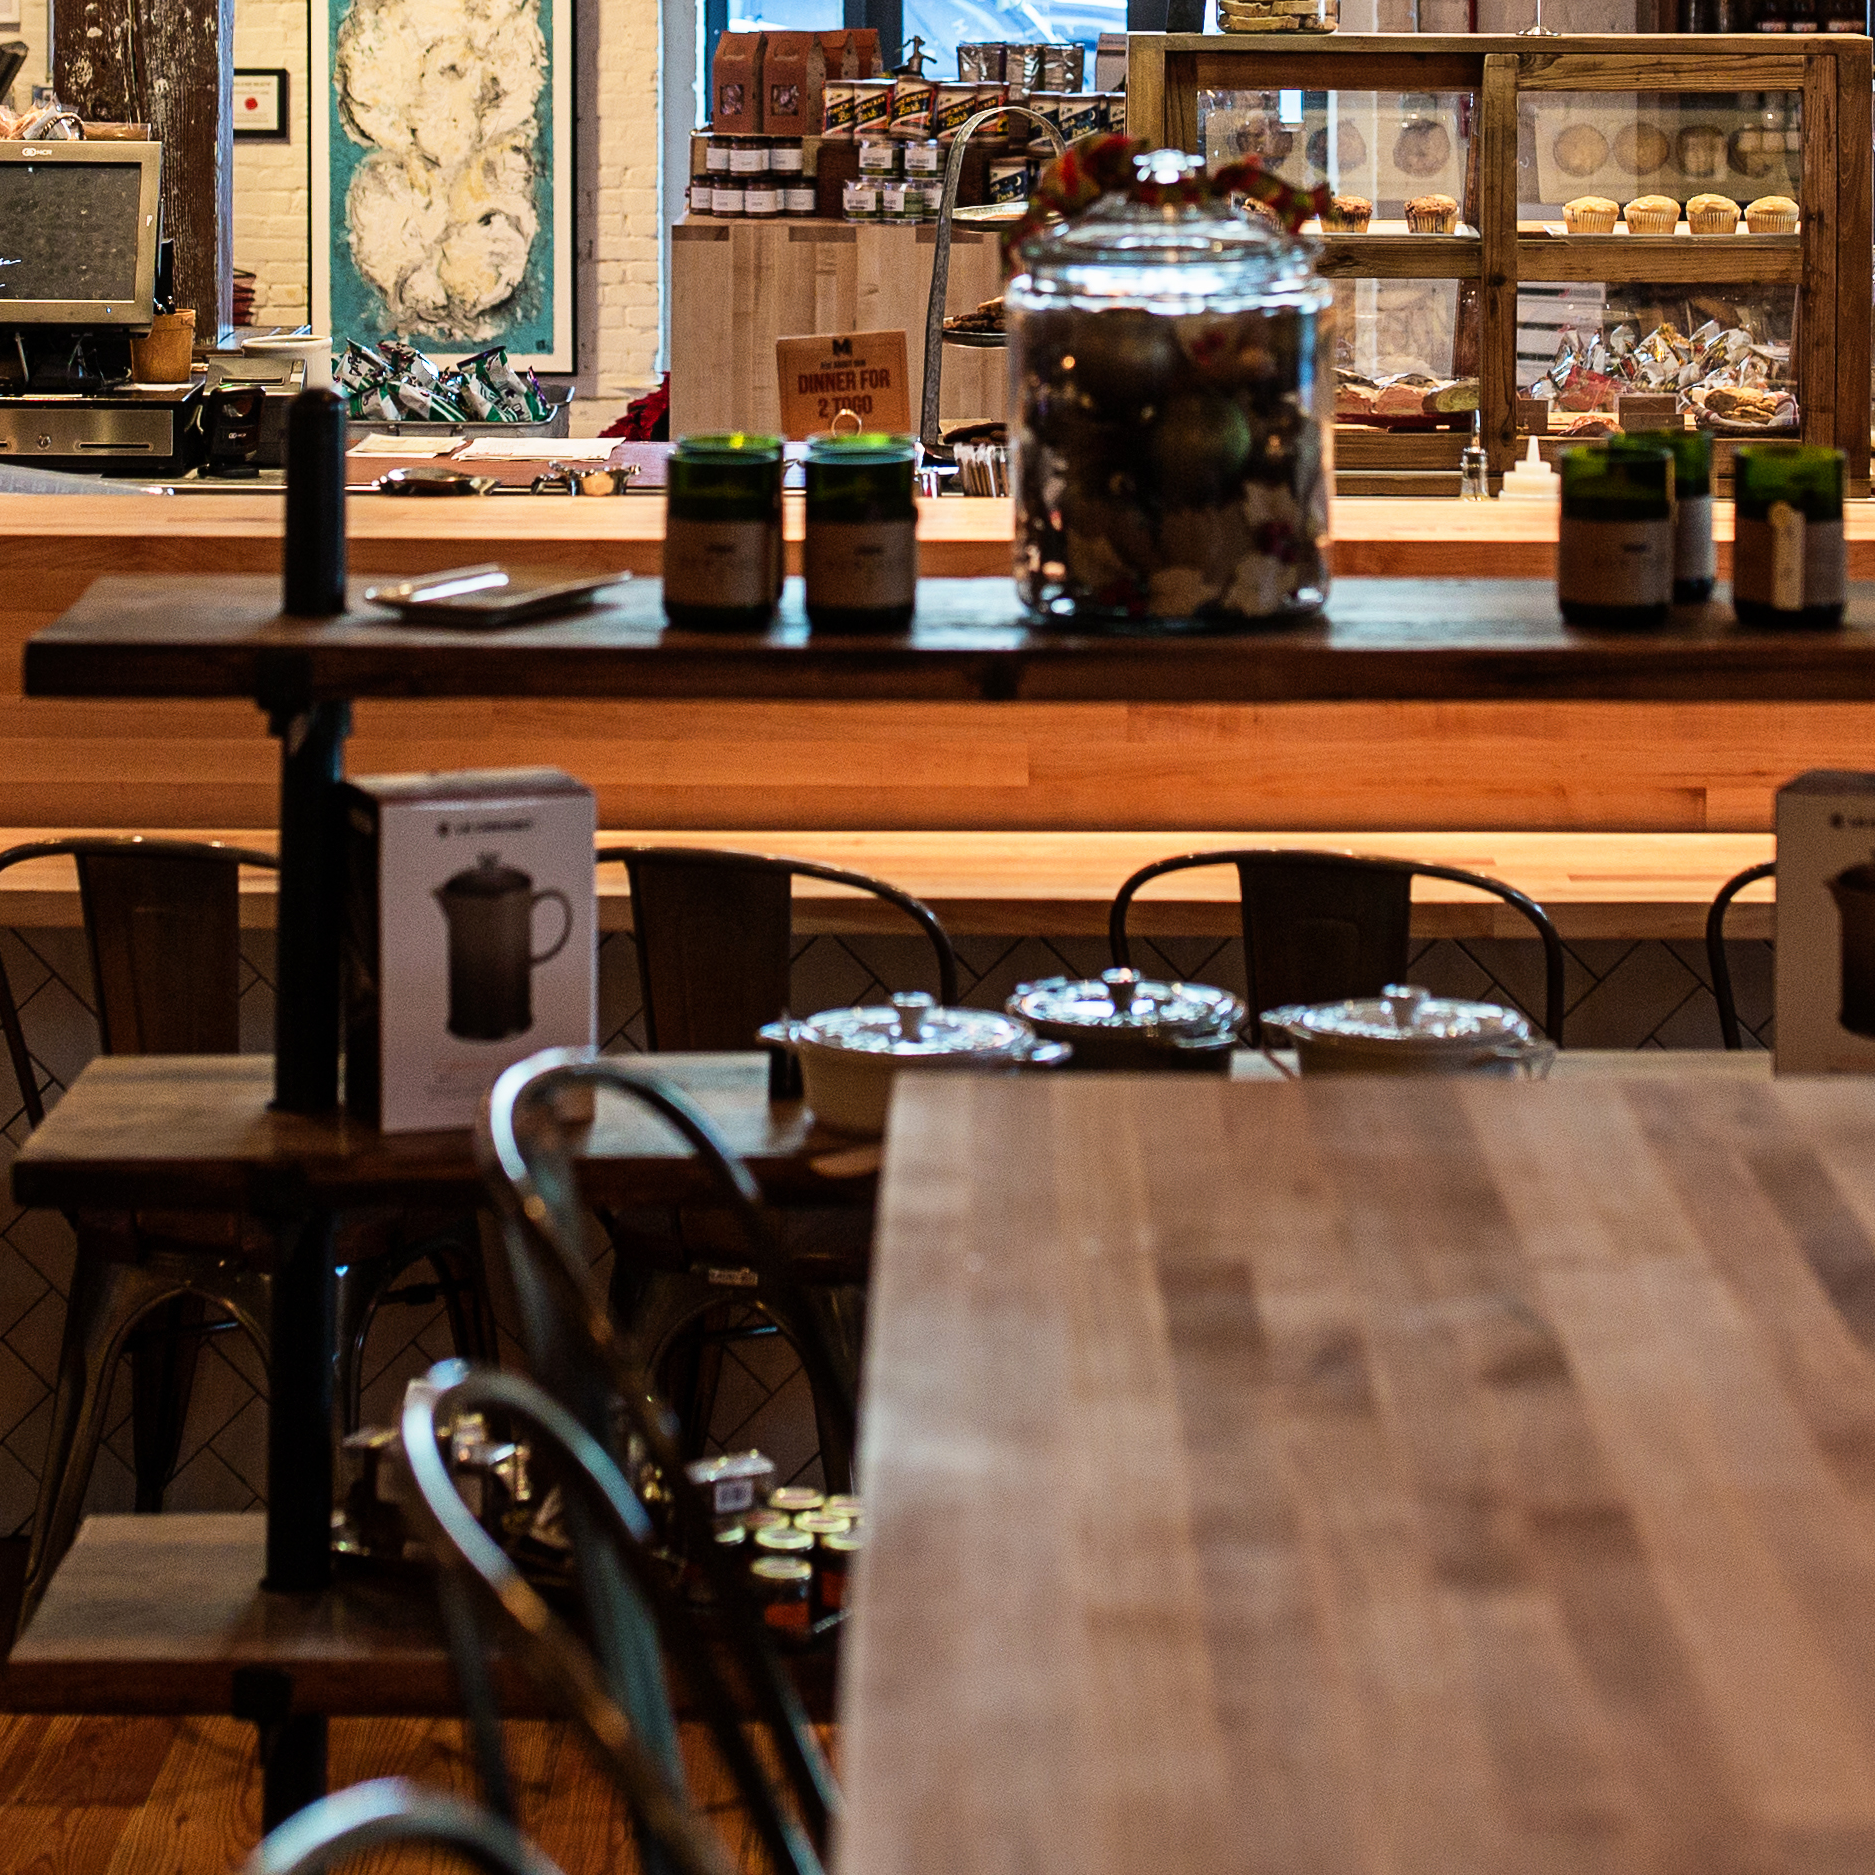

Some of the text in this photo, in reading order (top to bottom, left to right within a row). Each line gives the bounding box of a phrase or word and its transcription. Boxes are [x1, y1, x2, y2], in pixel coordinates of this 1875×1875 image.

[832, 337, 853, 356] M
[797, 367, 891, 395] DINNER FOR
[817, 396, 829, 418] 2
